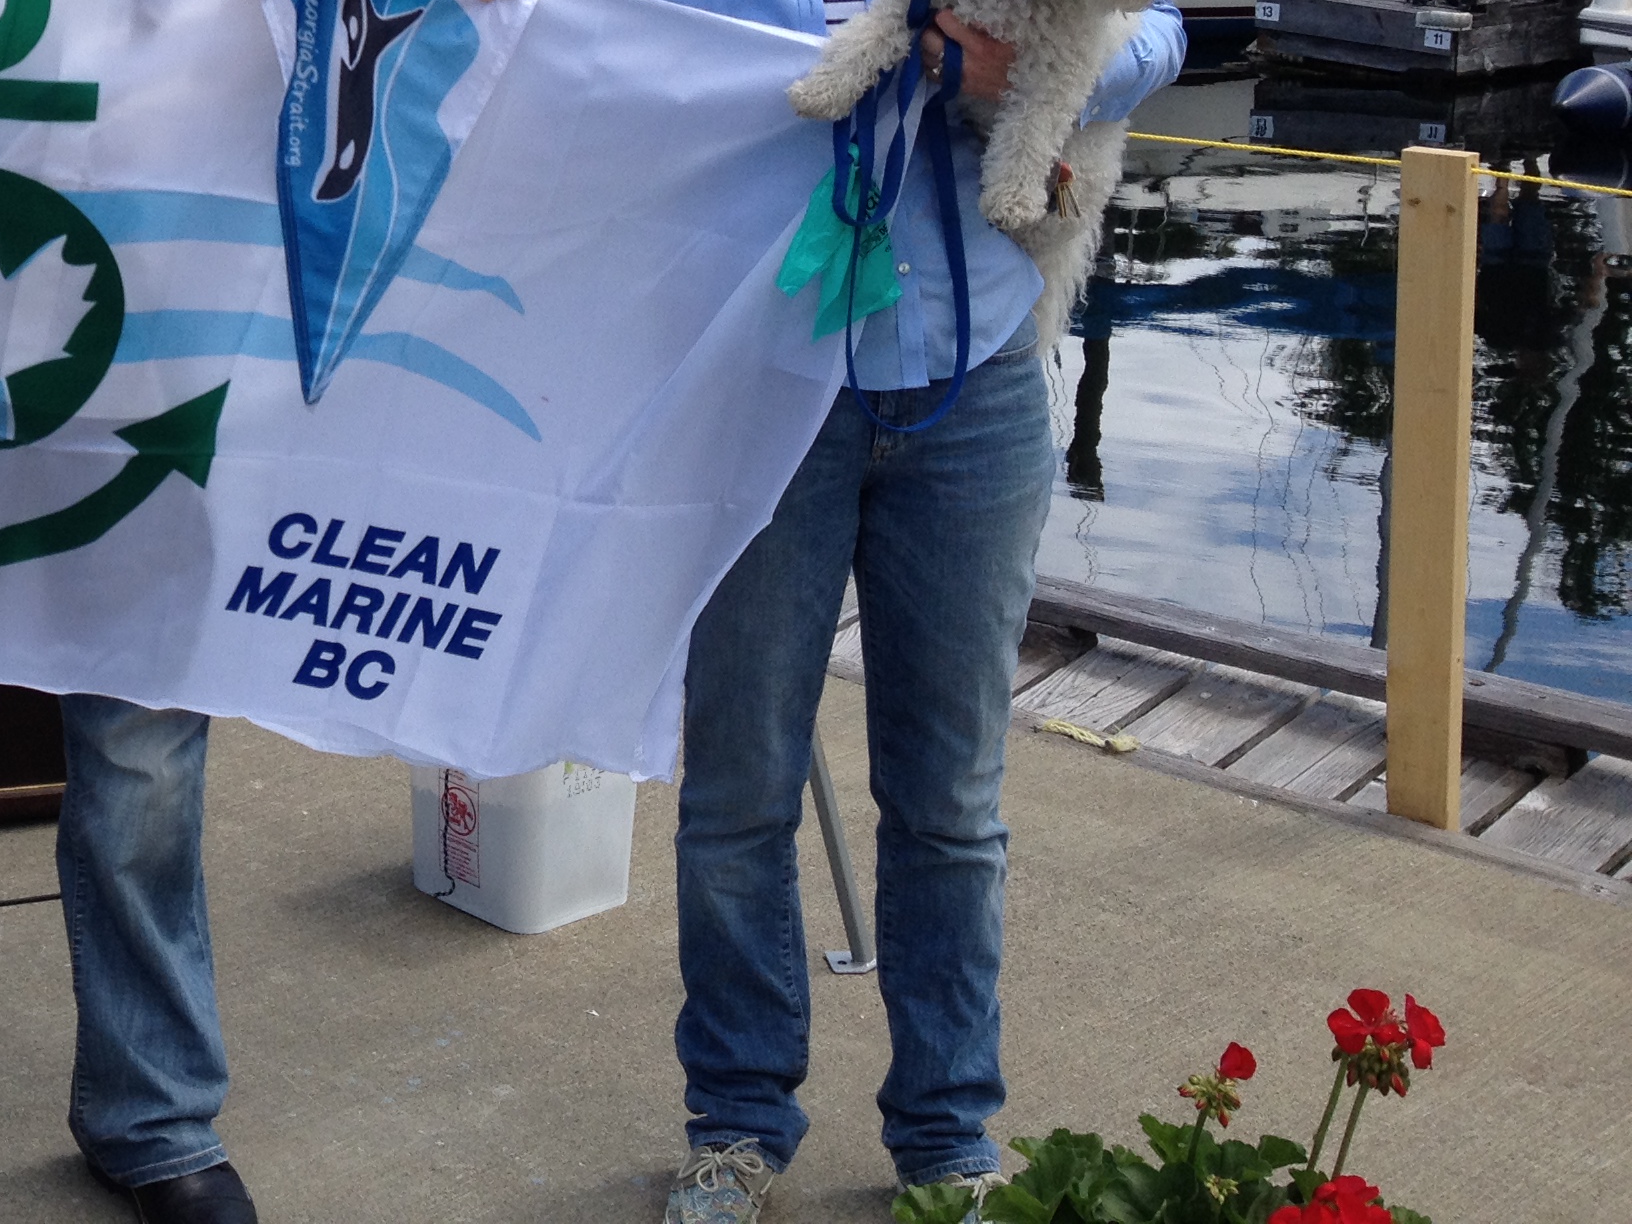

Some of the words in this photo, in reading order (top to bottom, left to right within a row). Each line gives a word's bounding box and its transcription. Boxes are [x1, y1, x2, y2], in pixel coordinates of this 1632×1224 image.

[1262, 5, 1273, 18] 13
[1433, 32, 1444, 45] 11
[268, 512, 501, 595] CLEAN
[225, 565, 503, 660] MARINE
[292, 639, 396, 700] BC
